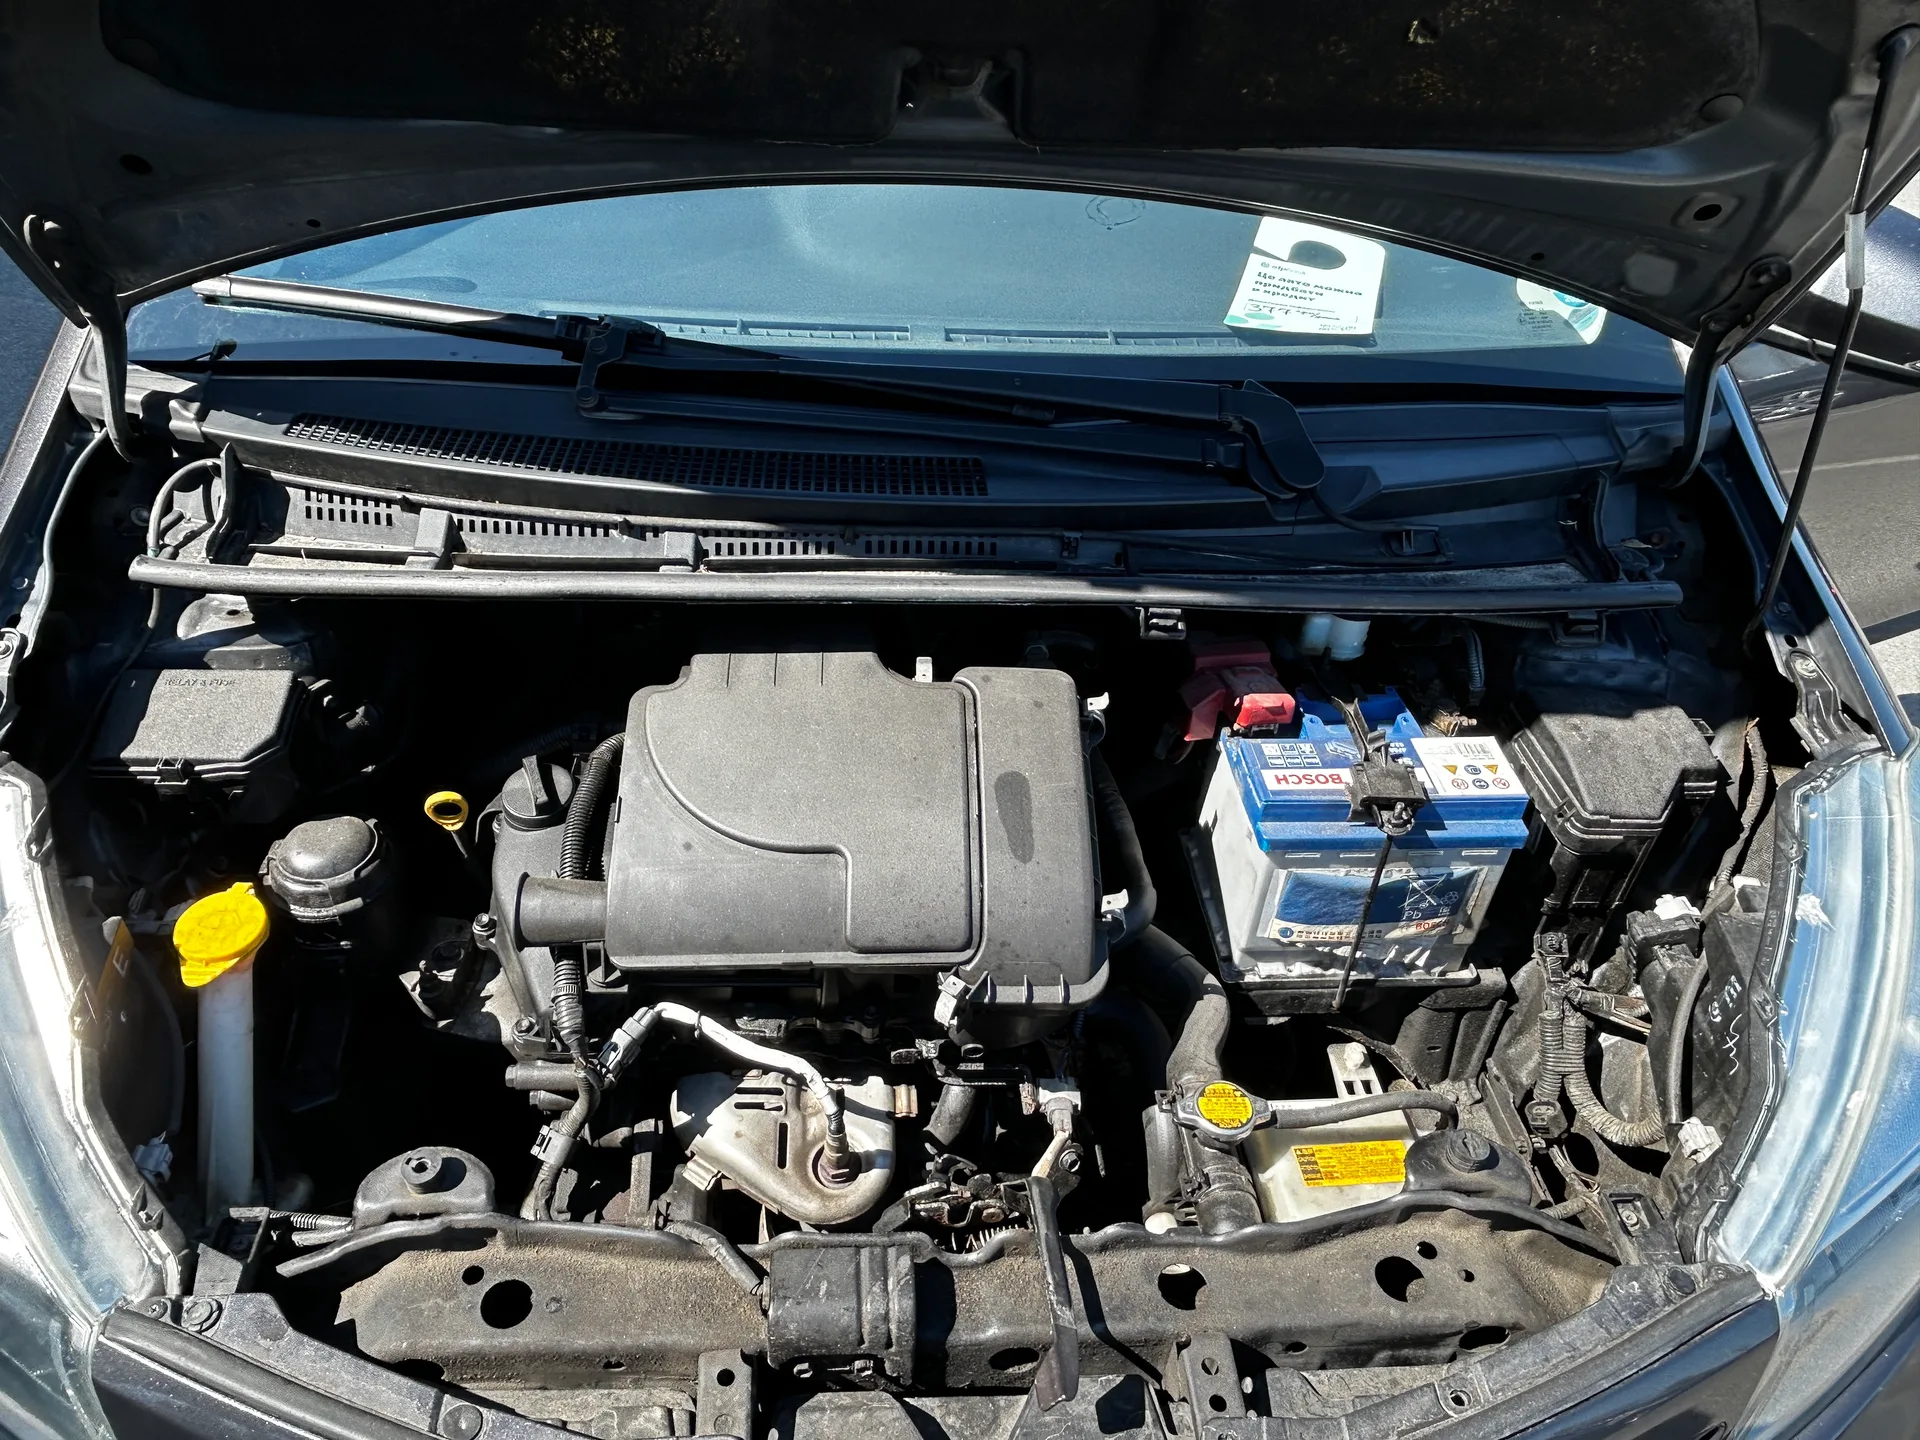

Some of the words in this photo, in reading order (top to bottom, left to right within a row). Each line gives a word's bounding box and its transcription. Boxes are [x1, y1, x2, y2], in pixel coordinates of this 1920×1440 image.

[1278, 277, 1310, 287] авто
[1313, 284, 1363, 296] можна
[165, 678, 198, 686] RELAY
[1274, 773, 1344, 785] BOSCH
[1402, 909, 1422, 920] Pb
